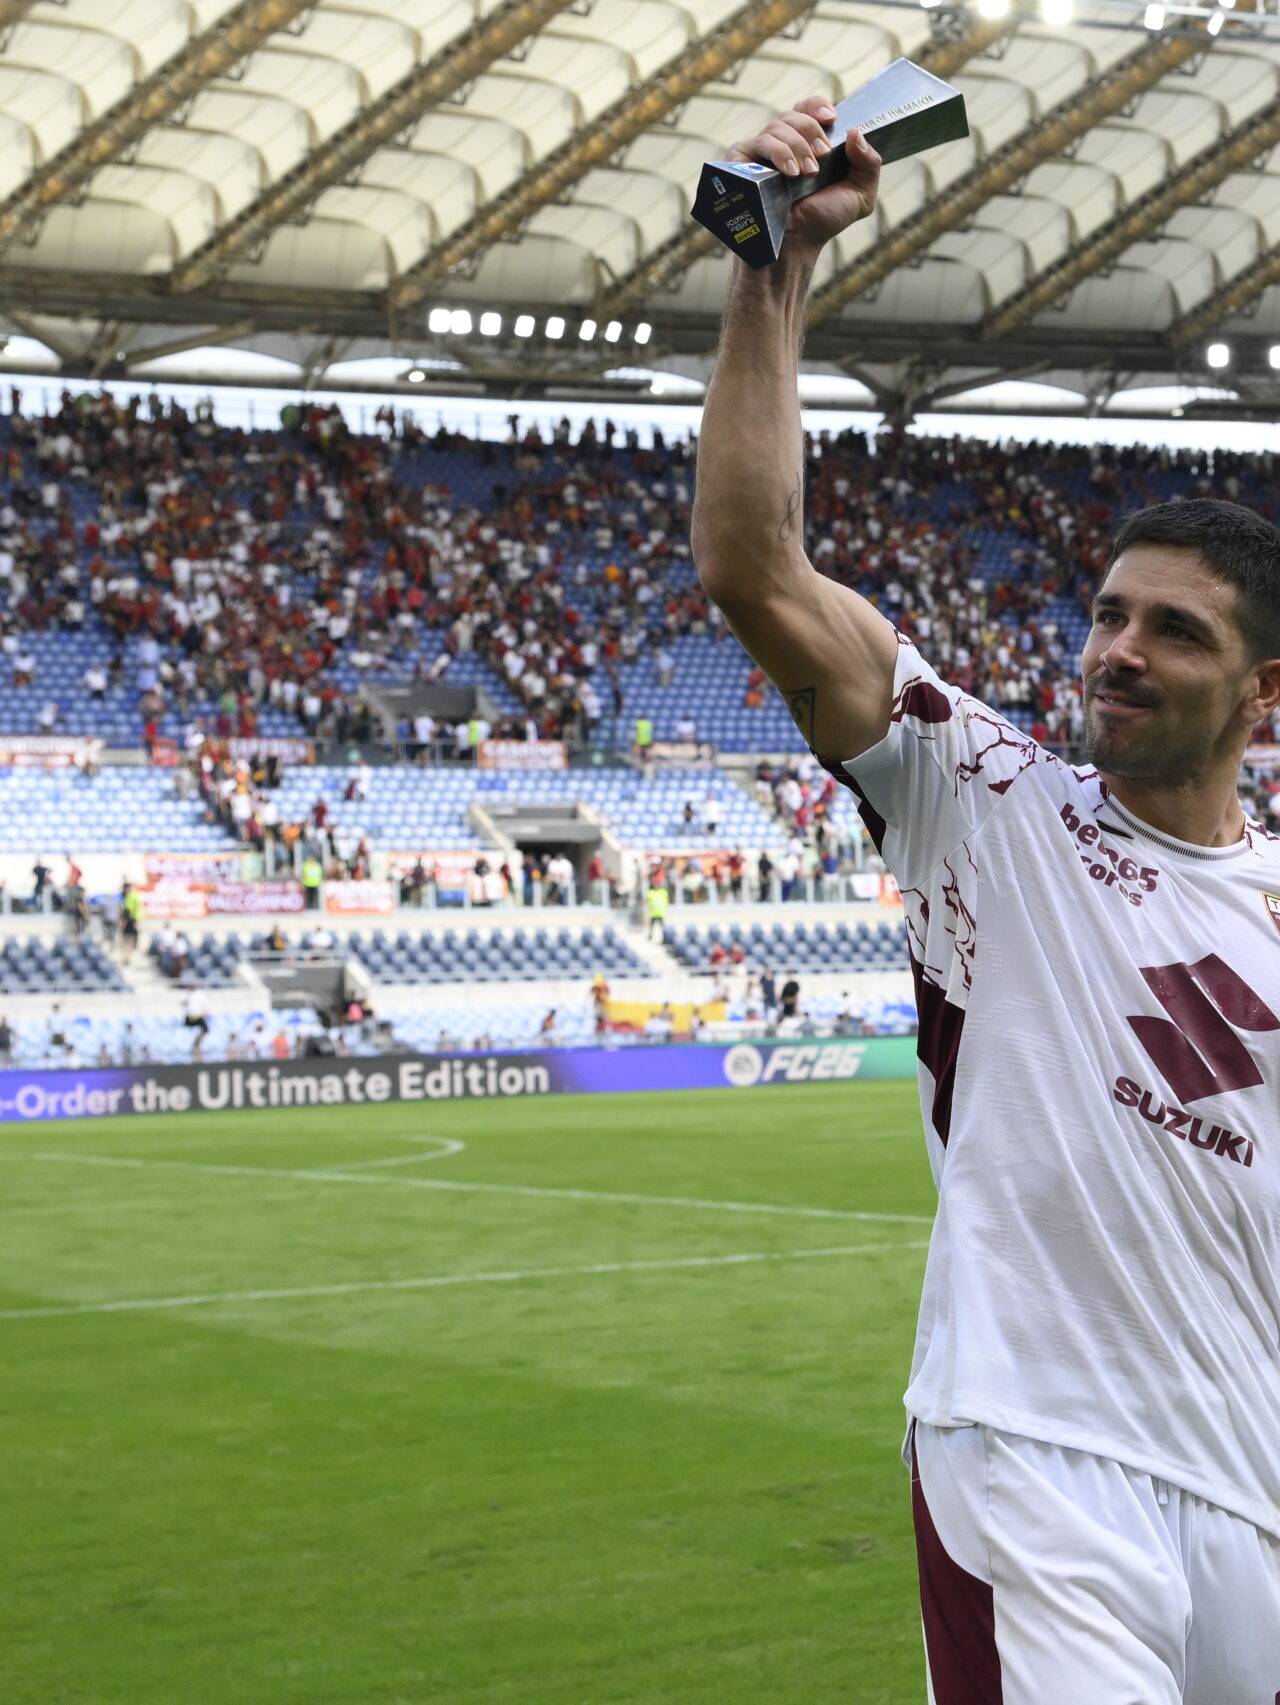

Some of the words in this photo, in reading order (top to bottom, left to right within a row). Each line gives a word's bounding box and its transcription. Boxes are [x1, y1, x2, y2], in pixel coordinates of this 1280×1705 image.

[726, 214, 745, 228] MATCH
[735, 216, 755, 231] PLAYER
[762, 1044, 867, 1081] FC26
[129, 1078, 192, 1113] the
[197, 1065, 391, 1110] Ultimate
[399, 1058, 550, 1100] Edition
[1113, 1076, 1254, 1168] SUZUKI
